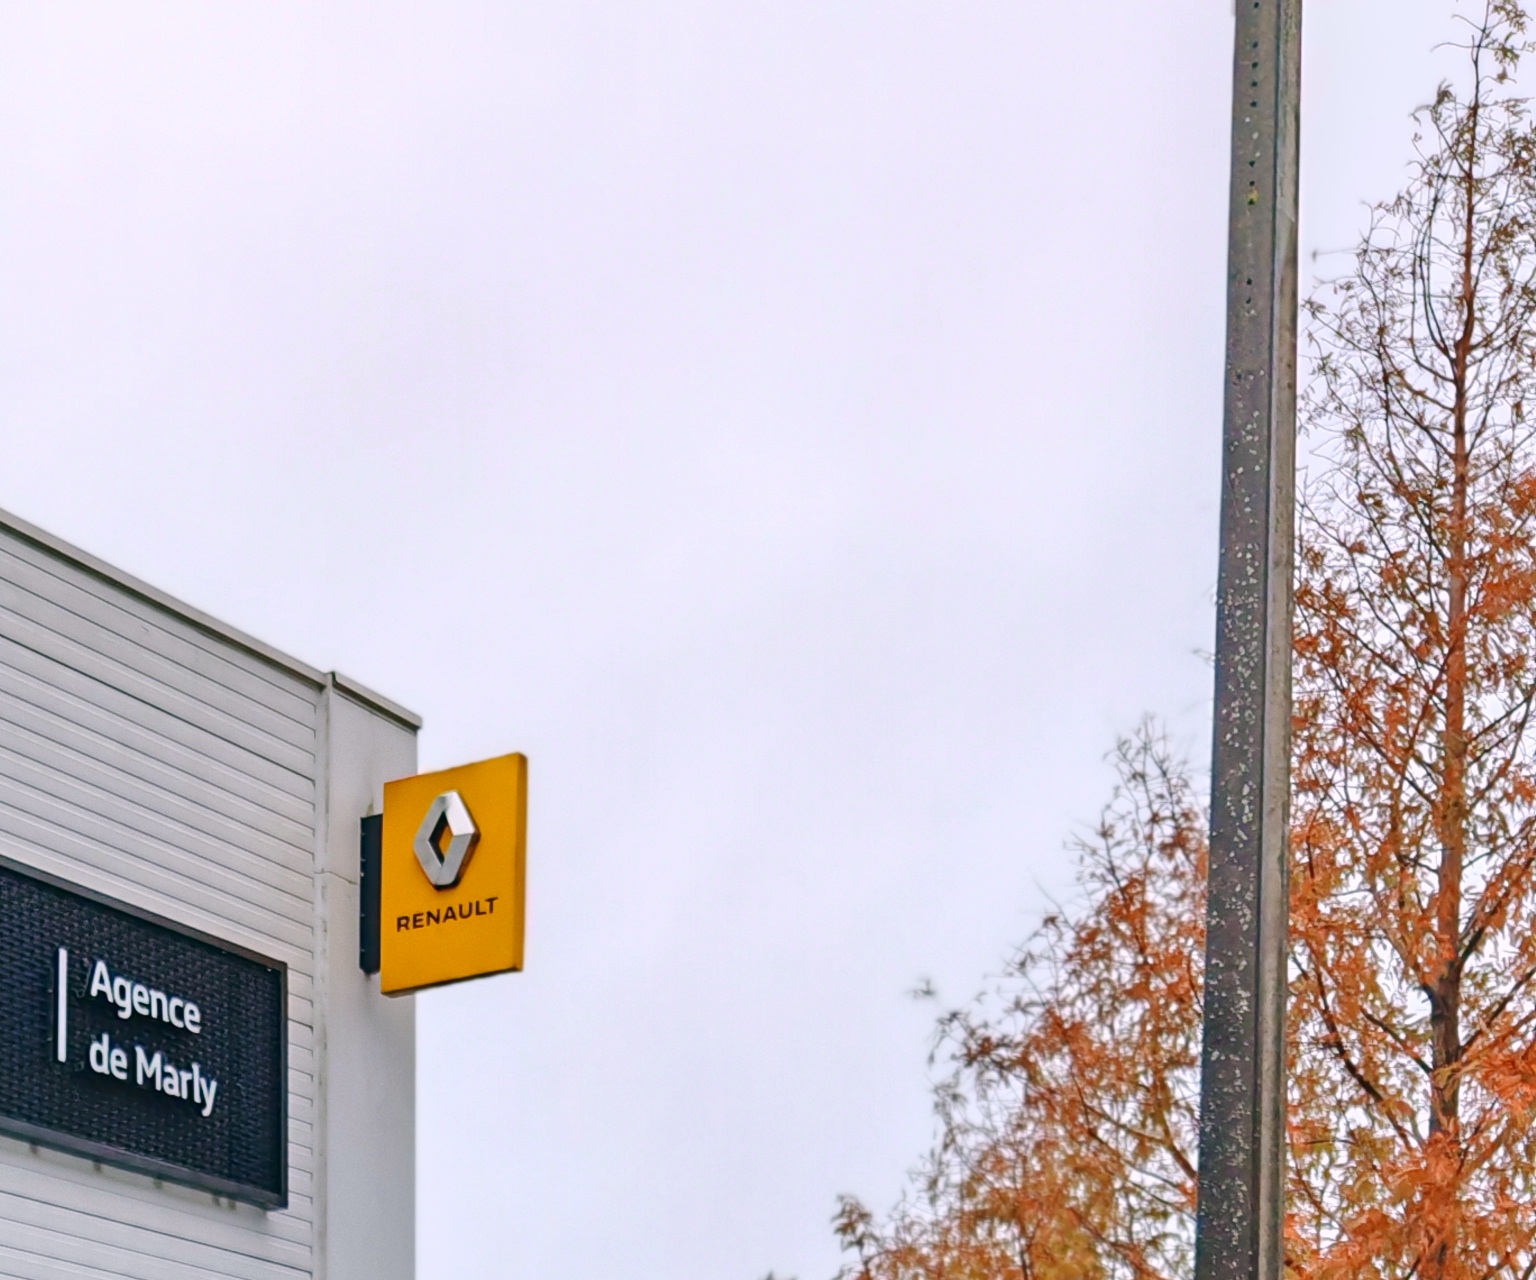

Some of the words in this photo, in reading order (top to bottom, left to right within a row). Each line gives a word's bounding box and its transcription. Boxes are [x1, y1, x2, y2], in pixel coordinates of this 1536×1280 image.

[396, 896, 500, 933] RENAULT
[90, 960, 202, 1035] Agence
[89, 1033, 128, 1081] de
[134, 1045, 219, 1118] Marly
